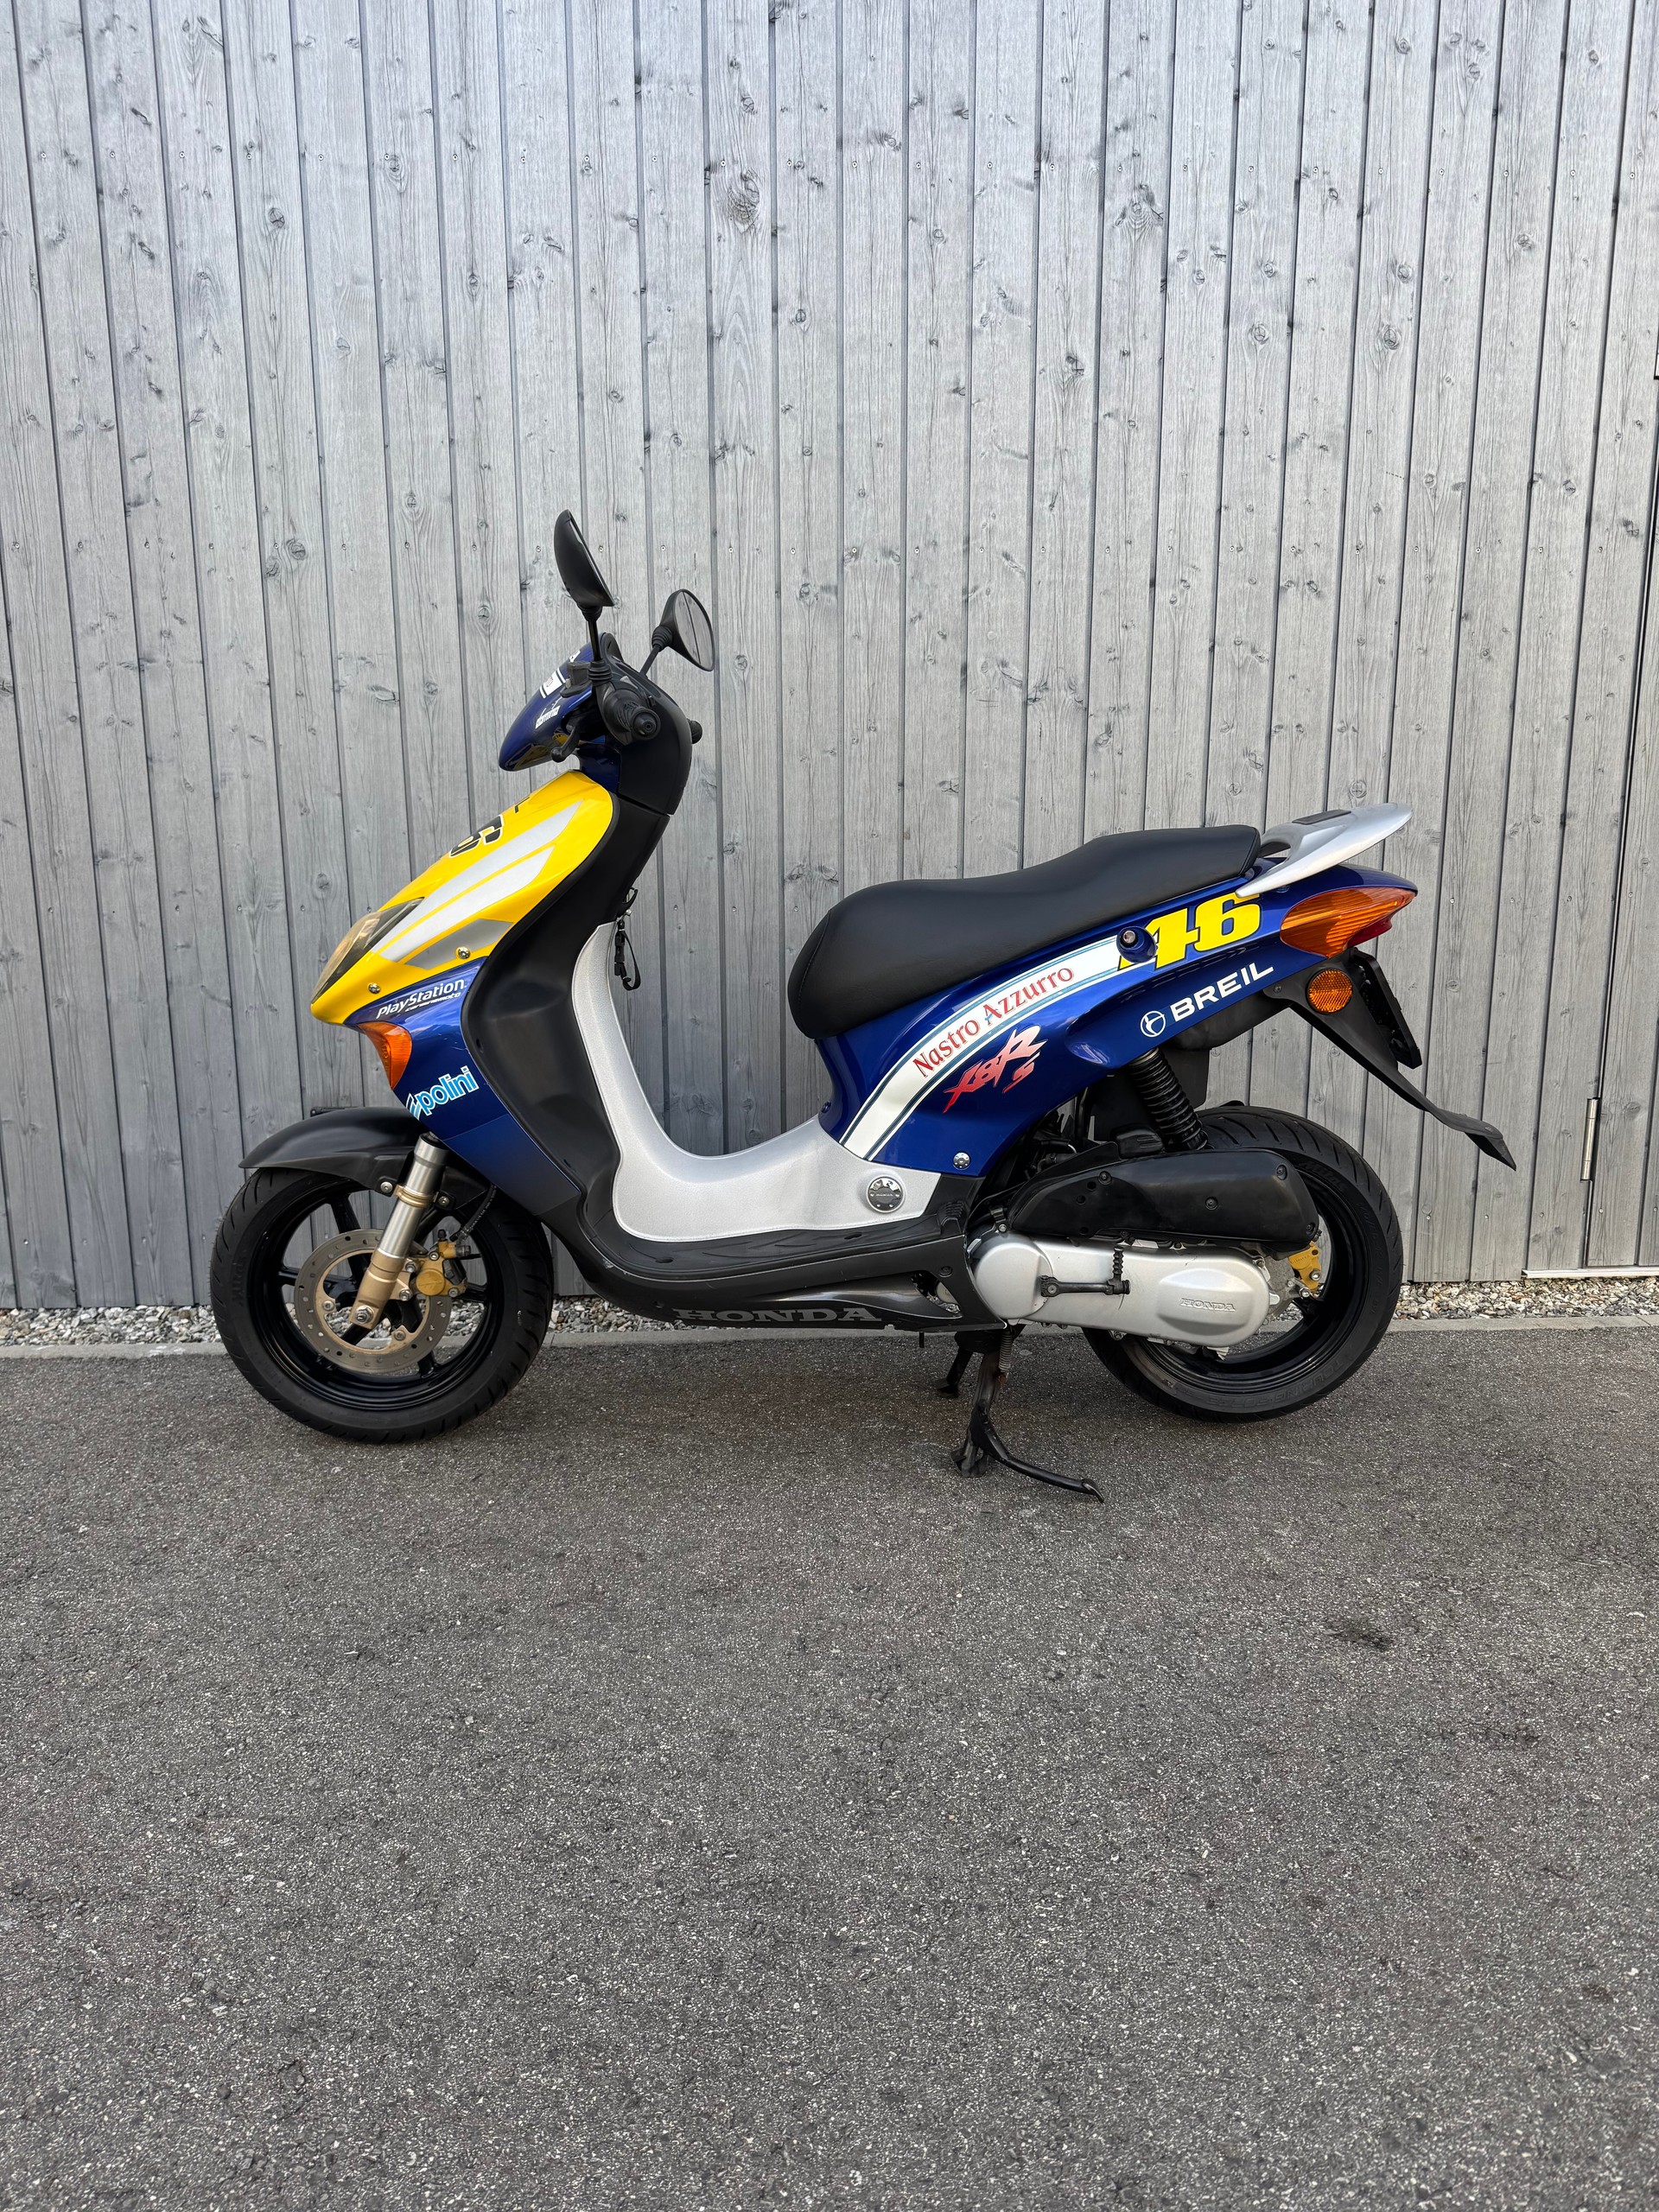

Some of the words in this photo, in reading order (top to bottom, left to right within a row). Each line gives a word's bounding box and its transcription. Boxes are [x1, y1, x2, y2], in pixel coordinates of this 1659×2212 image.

[1117, 891, 1262, 971] 46
[376, 979, 467, 1019] PlayStation
[1170, 963, 1274, 1022] BREIL
[912, 1020, 981, 1077] Nastro
[982, 968, 1075, 1026] Azzurro
[414, 1065, 479, 1116] polini
[671, 1307, 882, 1323] HONDA
[1179, 1298, 1236, 1313] HONDA
